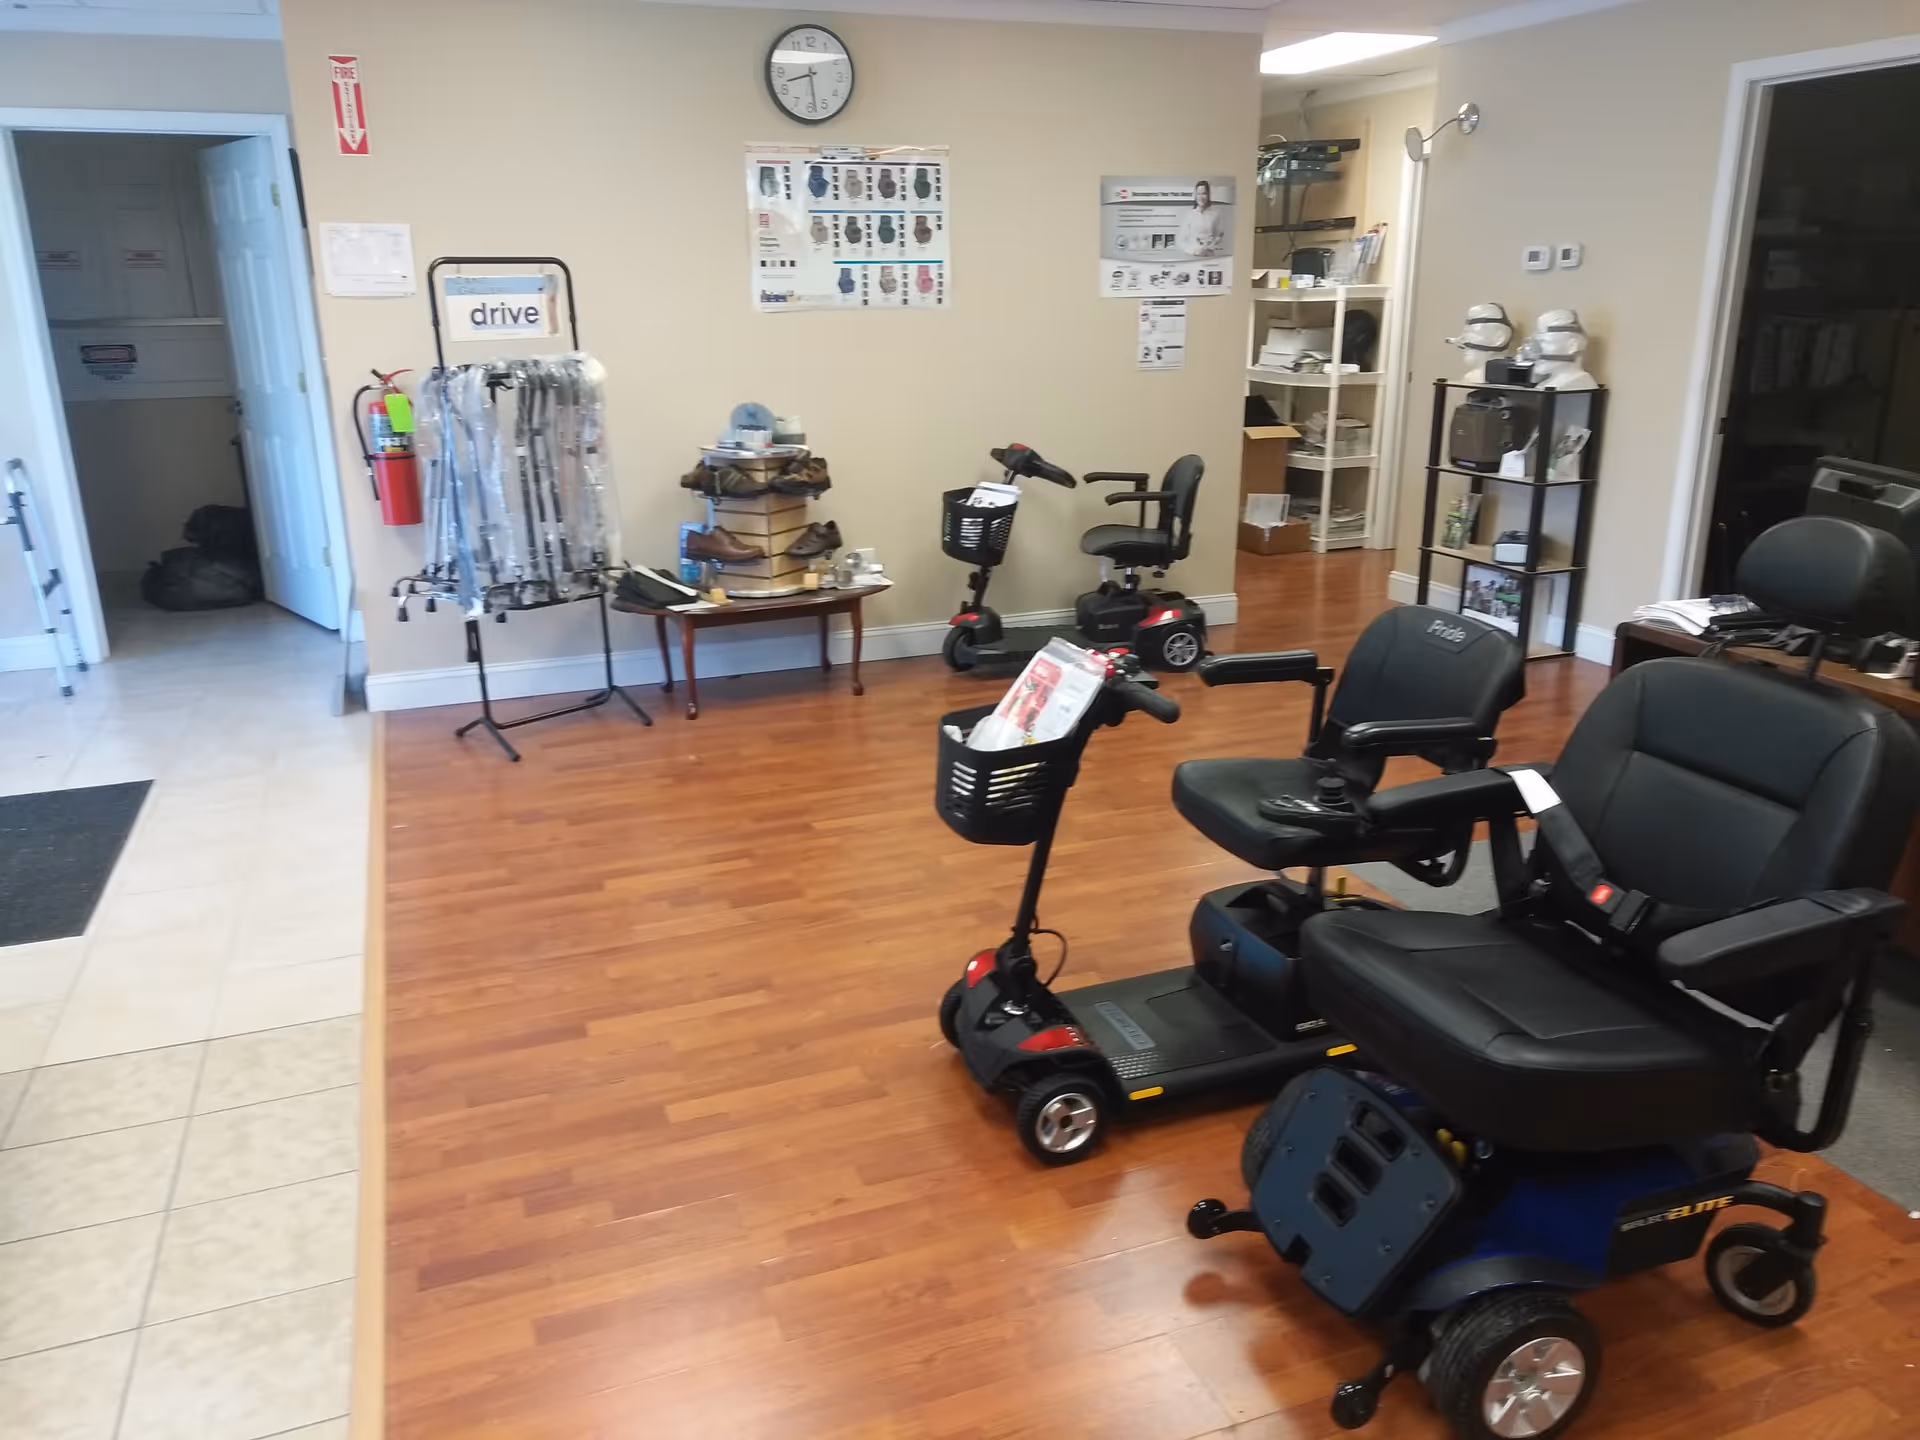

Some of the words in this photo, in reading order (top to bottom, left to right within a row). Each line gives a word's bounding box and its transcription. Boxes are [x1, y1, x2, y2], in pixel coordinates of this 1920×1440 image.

[792, 41, 801, 52] 11
[806, 36, 816, 48] 12
[777, 66, 785, 79] 9
[835, 71, 843, 84] 3
[781, 83, 789, 96] 8
[832, 88, 839, 97] 4
[792, 96, 801, 107] 7
[821, 98, 829, 110] 5
[470, 301, 540, 326] drive
[1425, 619, 1467, 643] Pride
